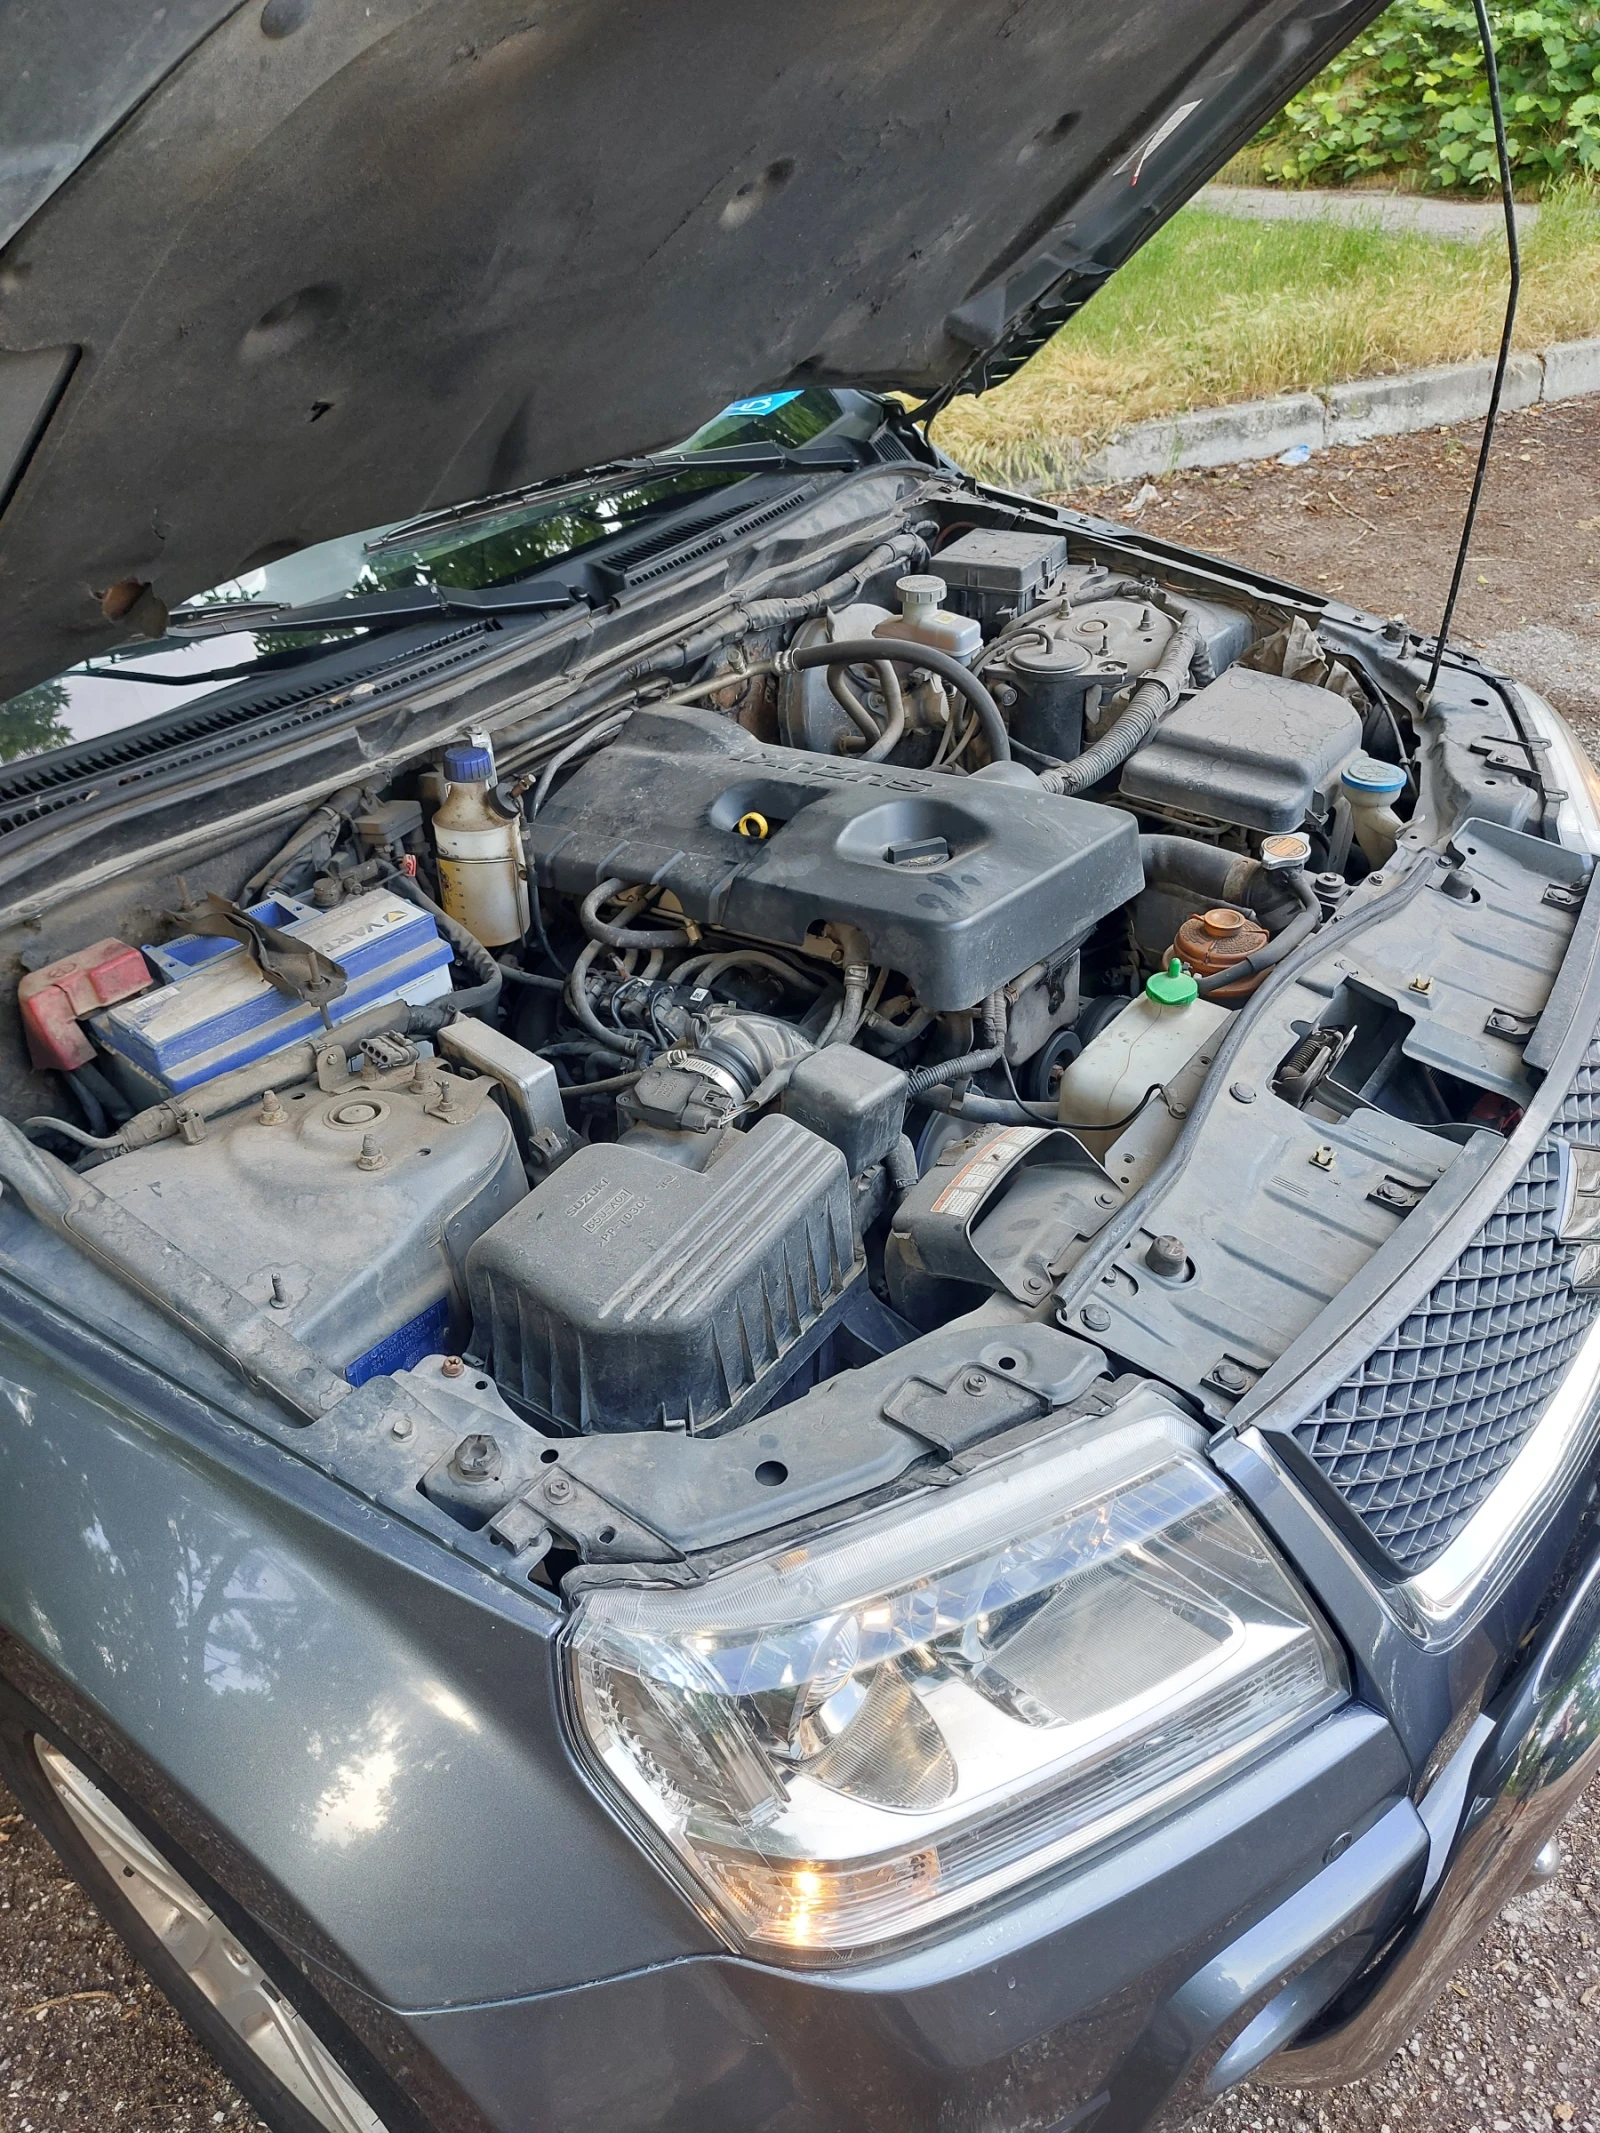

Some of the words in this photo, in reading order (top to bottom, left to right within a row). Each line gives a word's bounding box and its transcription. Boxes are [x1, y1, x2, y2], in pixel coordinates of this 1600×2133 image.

[729, 752, 934, 793] SUZUKI
[565, 1177, 609, 1217] SUZUKI
[585, 1190, 629, 1230] 65J-A01
